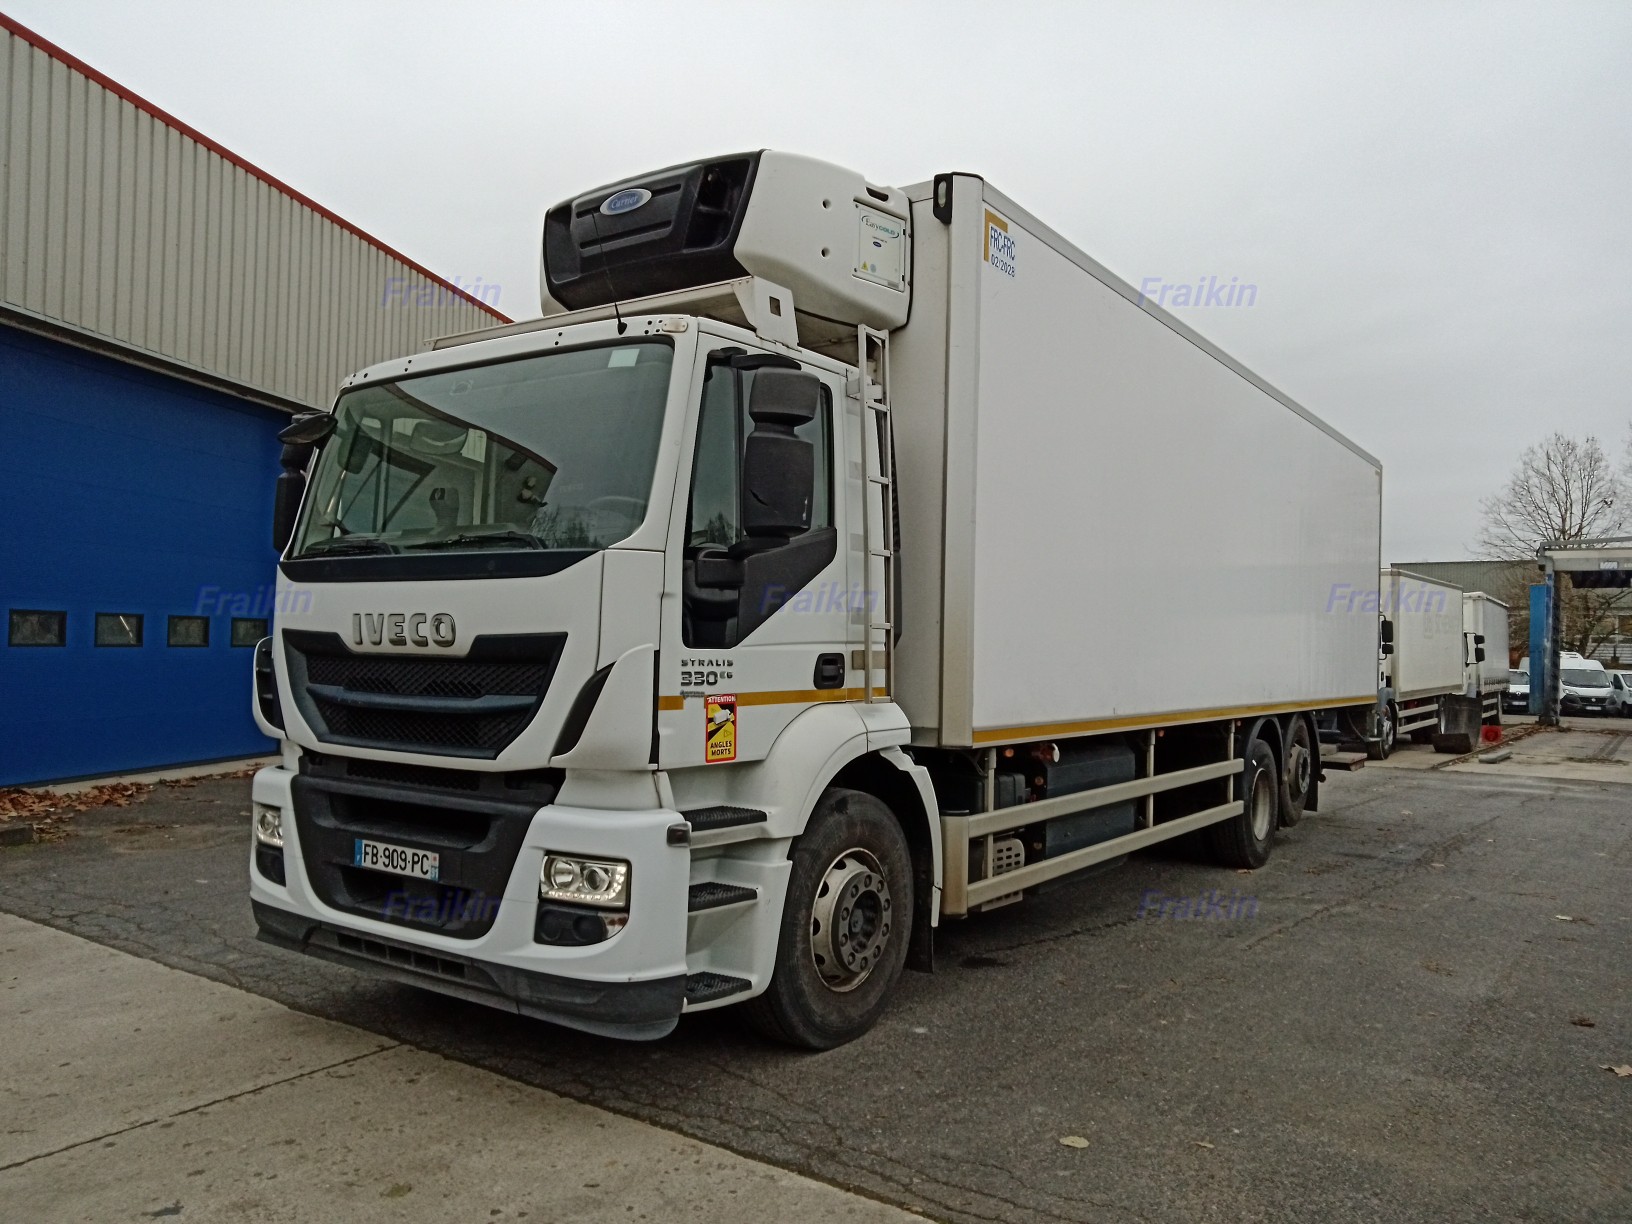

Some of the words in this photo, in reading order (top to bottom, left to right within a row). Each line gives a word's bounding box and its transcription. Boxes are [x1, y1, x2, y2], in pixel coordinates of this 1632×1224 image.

[352, 612, 456, 648] IVECO
[681, 671, 718, 686] 330
[711, 748, 731, 756] MORTS
